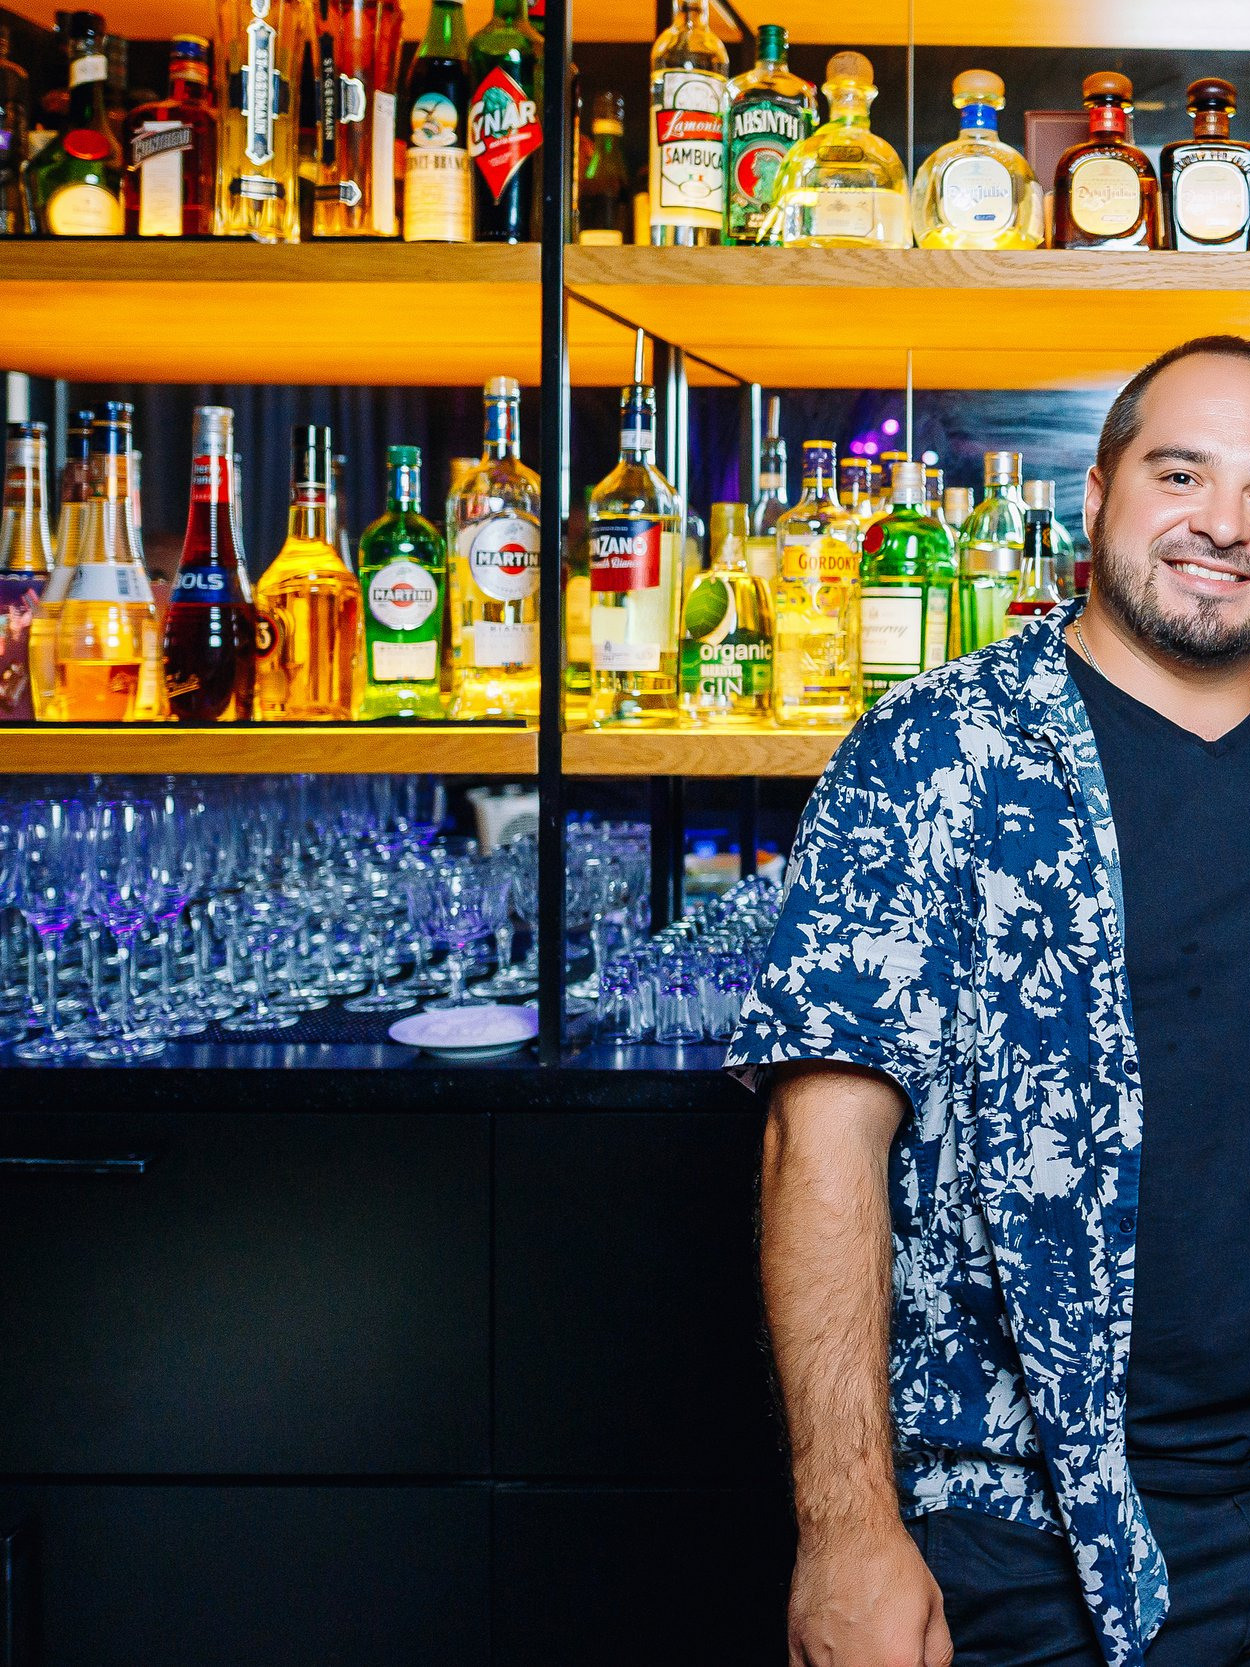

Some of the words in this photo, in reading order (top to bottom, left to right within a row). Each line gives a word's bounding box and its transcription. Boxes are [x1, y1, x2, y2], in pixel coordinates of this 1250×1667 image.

[468, 100, 537, 157] CYNAR
[732, 108, 801, 141] ABSINTH
[477, 551, 541, 567] MARTIN
[374, 588, 432, 602] MARTINI
[700, 640, 773, 667] organic
[700, 678, 743, 696] GIN
